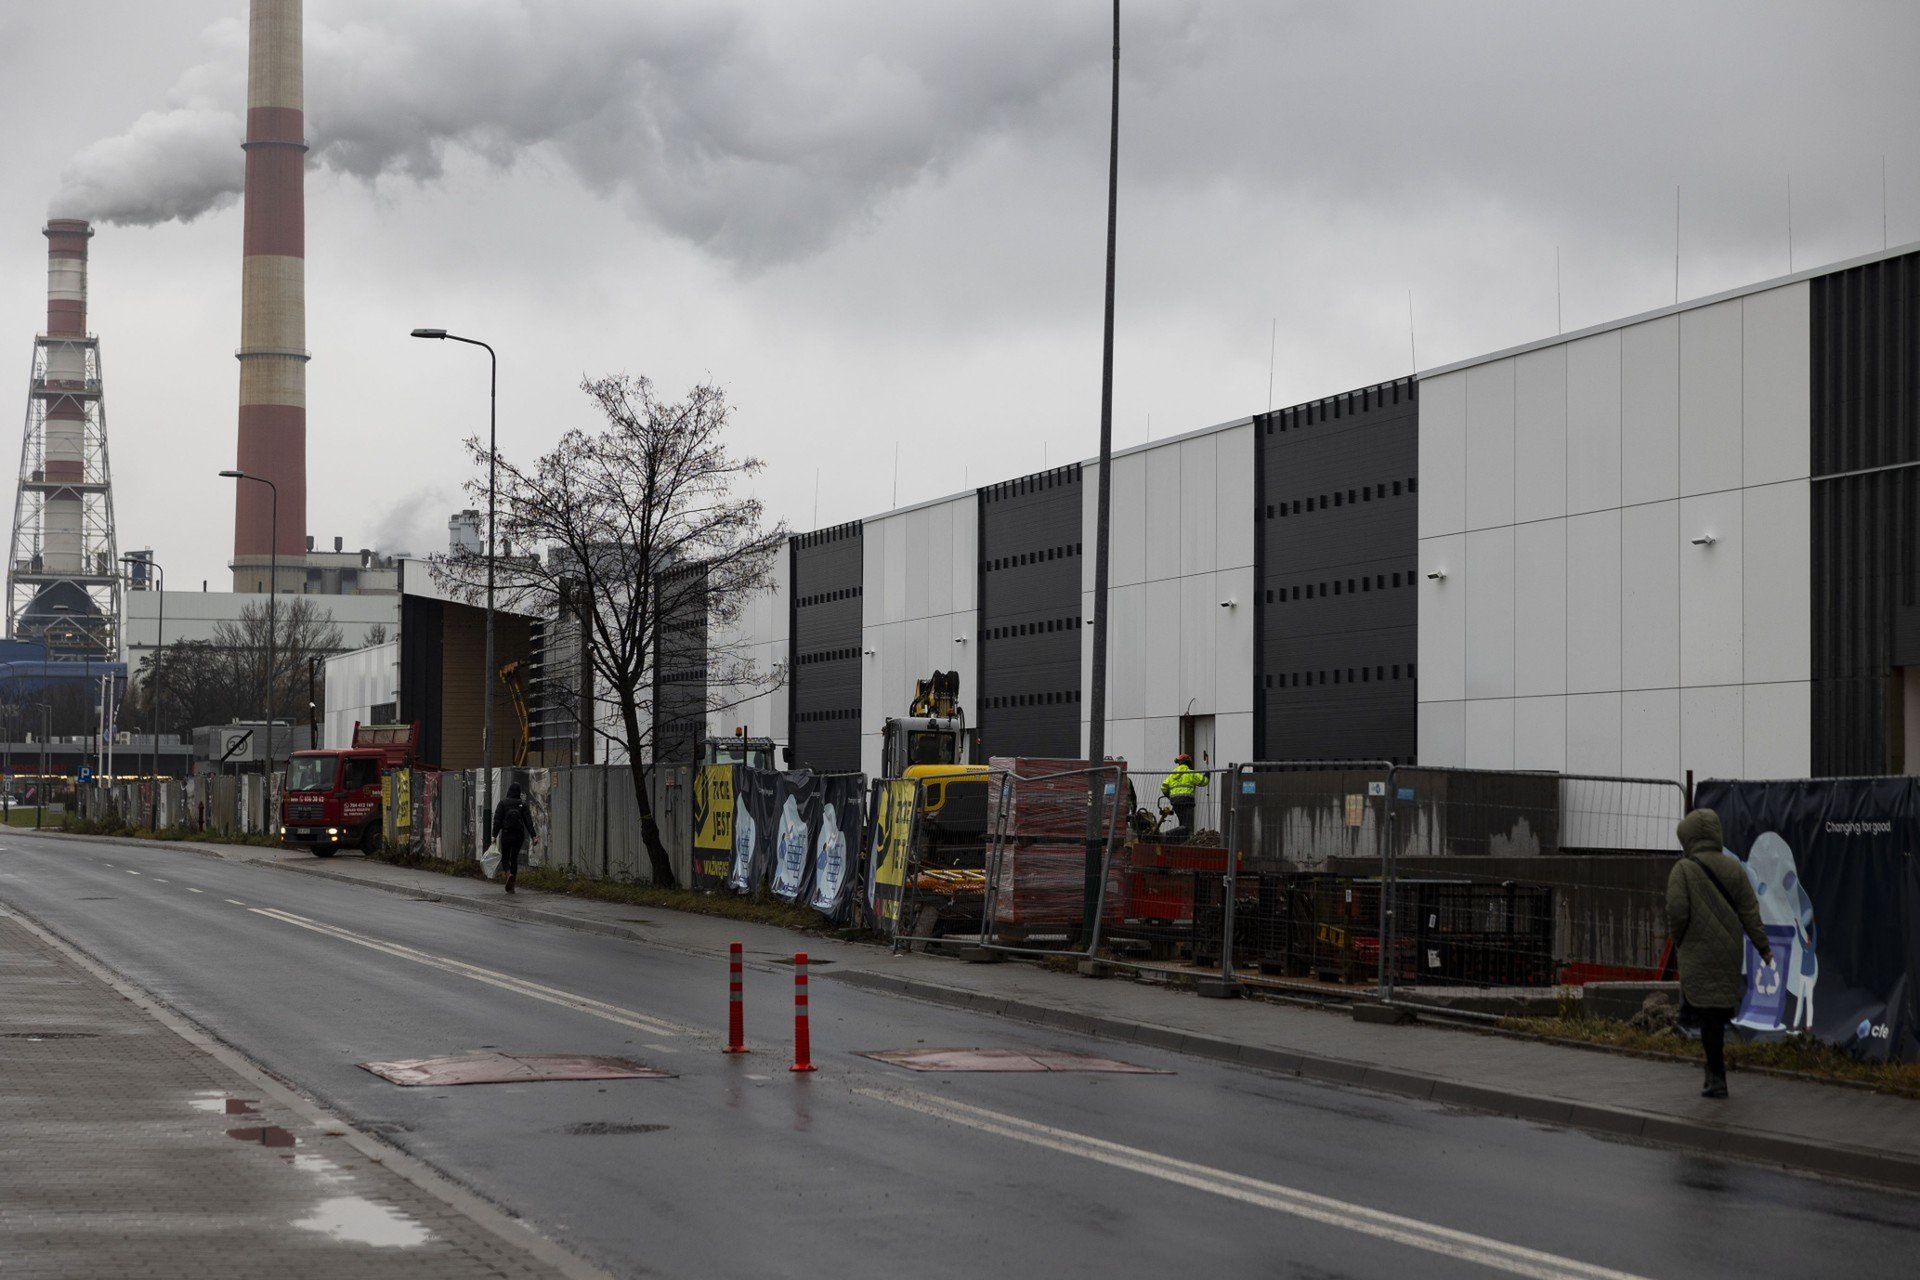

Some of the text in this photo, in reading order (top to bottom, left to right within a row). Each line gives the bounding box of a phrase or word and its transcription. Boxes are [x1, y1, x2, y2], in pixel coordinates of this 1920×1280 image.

[82, 767, 89, 778] P
[713, 811, 731, 842] JEST
[1825, 821, 1861, 836] Changing
